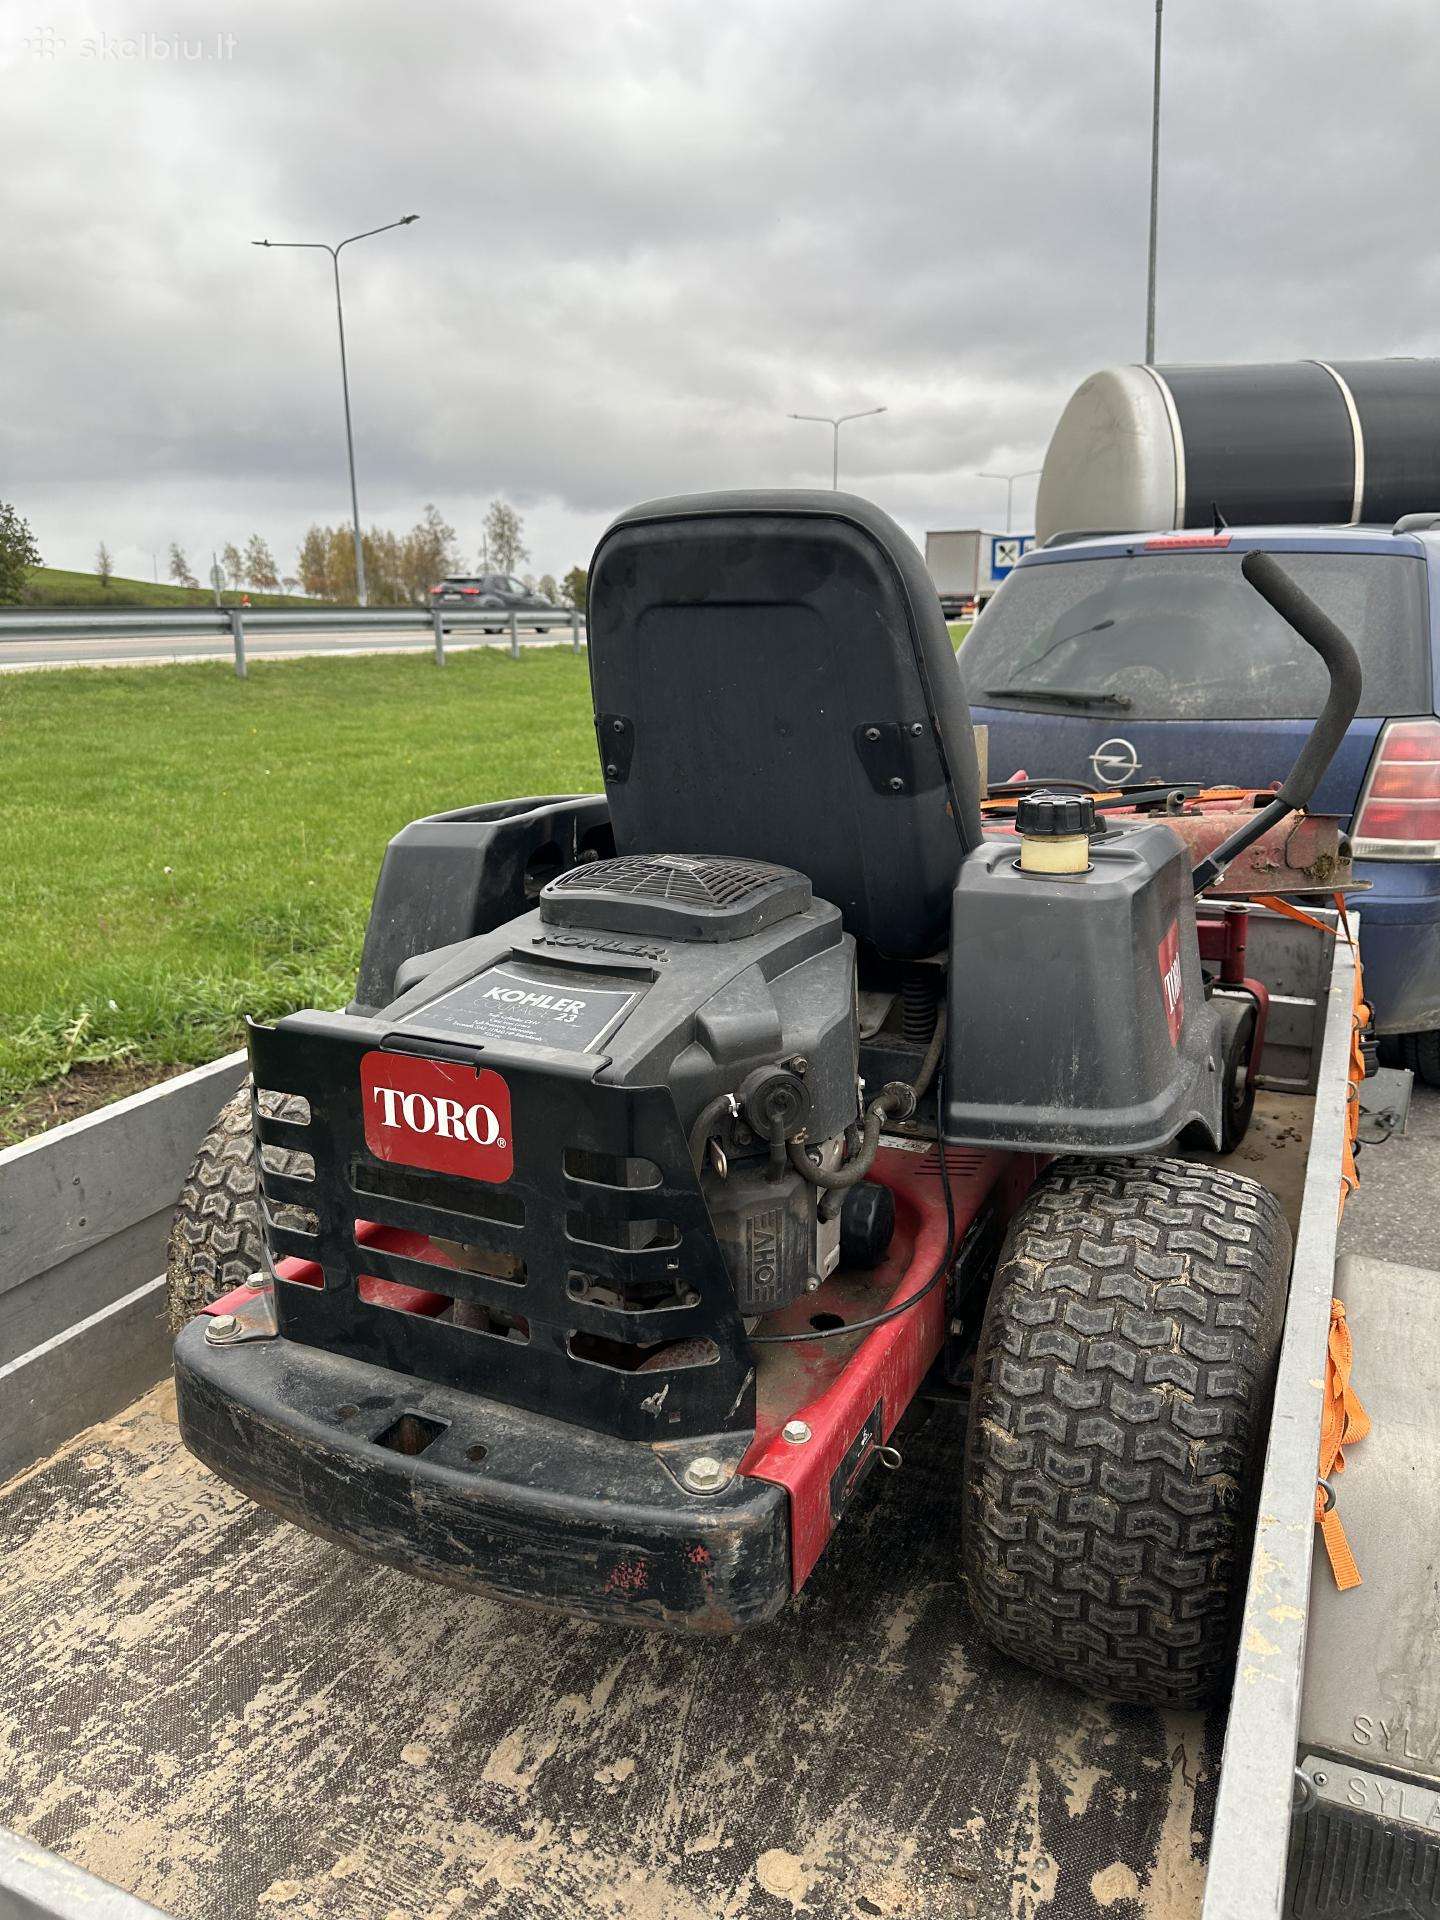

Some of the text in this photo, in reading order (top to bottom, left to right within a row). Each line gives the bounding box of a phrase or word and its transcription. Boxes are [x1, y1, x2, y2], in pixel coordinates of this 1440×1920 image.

[532, 934, 668, 961] KOHLER
[481, 987, 586, 1014] KOHLER
[554, 1013, 578, 1023] 23
[374, 1087, 500, 1147] TORO
